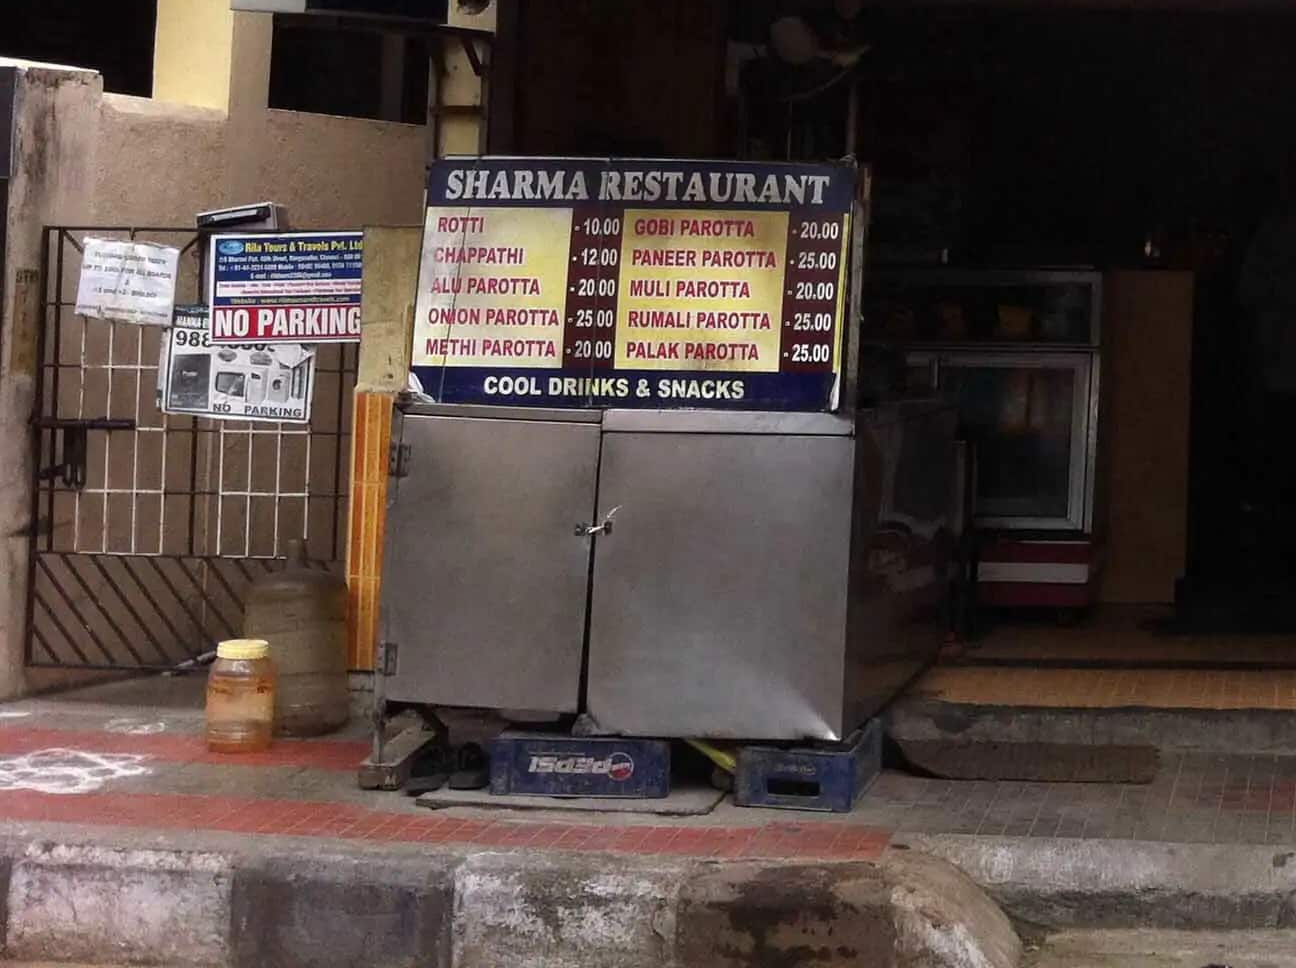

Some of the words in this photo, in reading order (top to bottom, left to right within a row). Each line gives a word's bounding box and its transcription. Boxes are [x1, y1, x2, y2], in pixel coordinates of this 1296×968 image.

[445, 169, 589, 201] SHARMA
[598, 171, 830, 205] RESTAURANT
[437, 217, 484, 233] ROTTI
[583, 218, 620, 235] 10.00
[634, 218, 675, 236] GOBI
[680, 220, 755, 237] PAROTTA
[800, 222, 839, 239] 20.00
[264, 242, 288, 252] Tours
[297, 241, 329, 251] Travels
[433, 247, 524, 264] CHAPPATHI
[632, 249, 696, 267] PANEER
[701, 250, 777, 268] PAROTTA
[797, 252, 836, 270] 25.00
[430, 277, 462, 294] ALU
[467, 278, 540, 295] PAROTTA
[630, 280, 670, 297] MULI
[675, 281, 751, 298] PAROTTA
[795, 282, 834, 300] 20.00
[214, 309, 250, 337] NO
[257, 307, 361, 336] PARKING
[428, 308, 481, 325] ONION
[486, 309, 560, 326] PAROTTA
[575, 309, 614, 327] 2500
[628, 311, 691, 329] RUMALI
[696, 311, 771, 330] PAROTTA
[793, 313, 832, 331] 25.00
[425, 339, 476, 356] METHI
[482, 340, 556, 357] PAROTTA
[573, 340, 612, 359] 2000
[626, 341, 681, 359] PALAK
[684, 342, 759, 360] PAROTTA
[792, 344, 830, 363] 25.00
[483, 376, 542, 395] COOL
[548, 377, 629, 397] DRINKS
[635, 378, 651, 398] &
[657, 379, 745, 400] SNACKS
[213, 403, 232, 412] NO
[244, 405, 301, 417] PARKING
[528, 756, 610, 774] PEPSI
